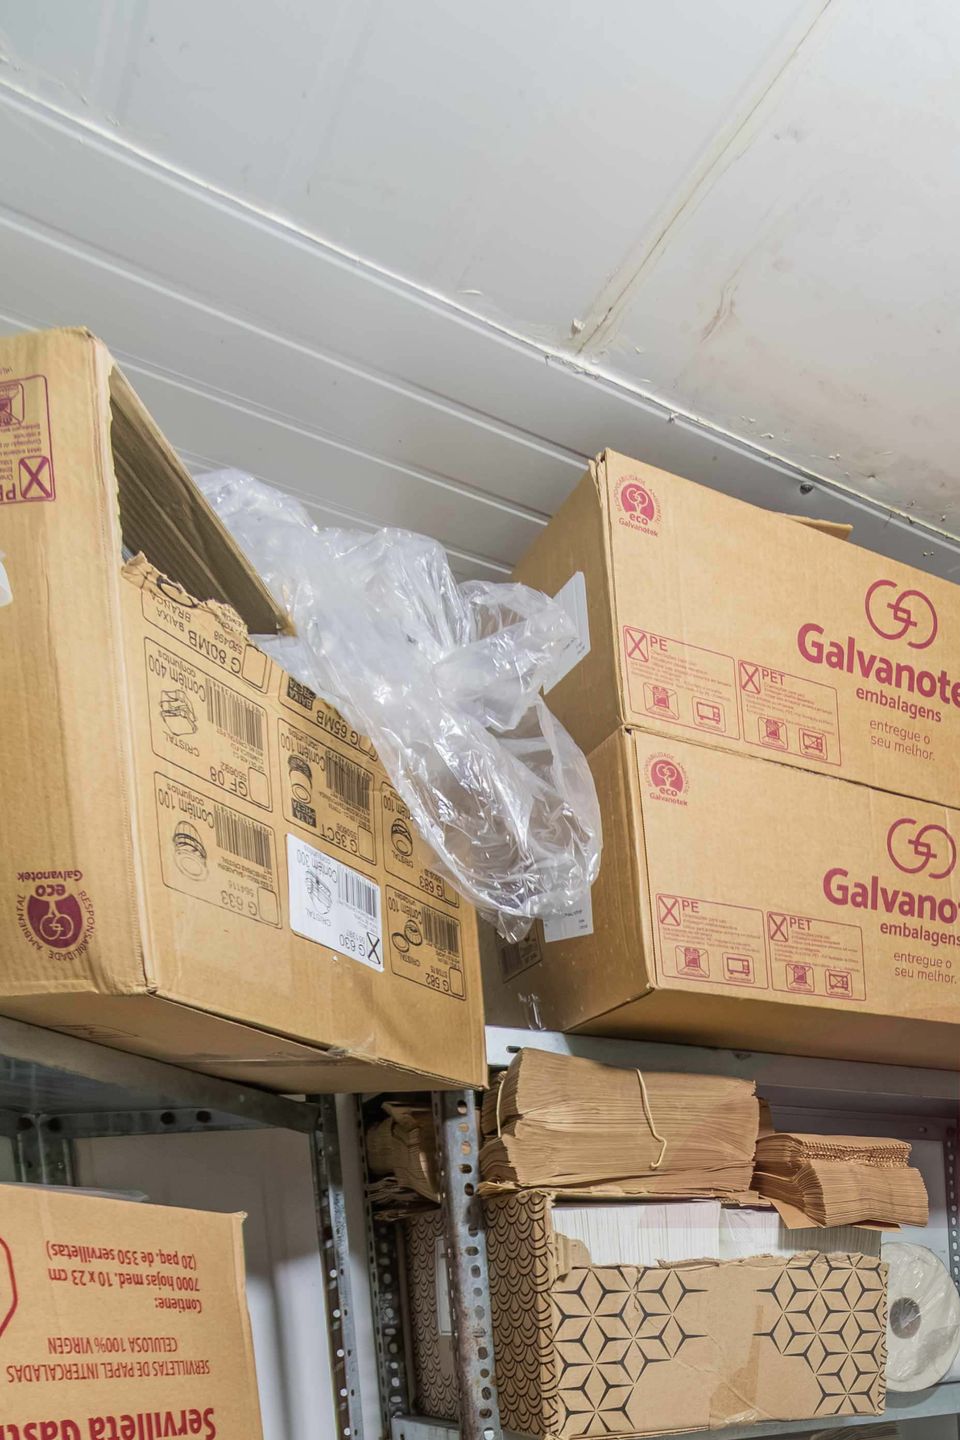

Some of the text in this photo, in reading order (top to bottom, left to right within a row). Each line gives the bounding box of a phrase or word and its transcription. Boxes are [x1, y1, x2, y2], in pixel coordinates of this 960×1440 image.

[619, 518, 658, 537] Galvanotek
[630, 514, 648, 525] eco
[156, 607, 184, 632] BAIXA
[188, 630, 241, 674] G 80MB
[650, 636, 668, 652] PE
[149, 655, 166, 678] 400
[158, 651, 196, 678] conjuntos
[169, 670, 206, 702] Contém
[762, 669, 785, 685] PET
[856, 687, 942, 722] embalagens
[316, 710, 358, 746] G 65MB
[870, 719, 930, 745] entregue o
[163, 731, 200, 757] CRISTAL
[280, 733, 294, 752] 100
[871, 734, 935, 761] seu melhor.
[297, 742, 325, 772] Contém
[210, 766, 247, 797] GF 08
[659, 787, 677, 797] eco
[158, 789, 175, 810] 100
[166, 783, 204, 806] conjuntos
[179, 799, 214, 828] Contém
[321, 824, 357, 853] G 35CT
[17, 870, 83, 882] Galvanotek
[35, 884, 66, 897] eco
[436, 885, 443, 897] G
[221, 890, 257, 916] G 633
[681, 900, 700, 914] PE
[789, 918, 813, 931] PET
[340, 934, 365, 956] G 630
[894, 952, 952, 968] entregue o
[443, 980, 449, 992] G
[894, 967, 957, 985] seu melhor.
[46, 1241, 197, 1271] (20 paq. de 350 servilletas)
[48, 1268, 200, 1291] 7000 hojas med. 10 x 23 cm
[154, 1297, 202, 1314] Contiene:
[48, 1337, 177, 1354] CELULOSA 100% VIRGEN
[6, 1359, 210, 1383] SERVILLETAS DE PAPEL INTERCALADAS
